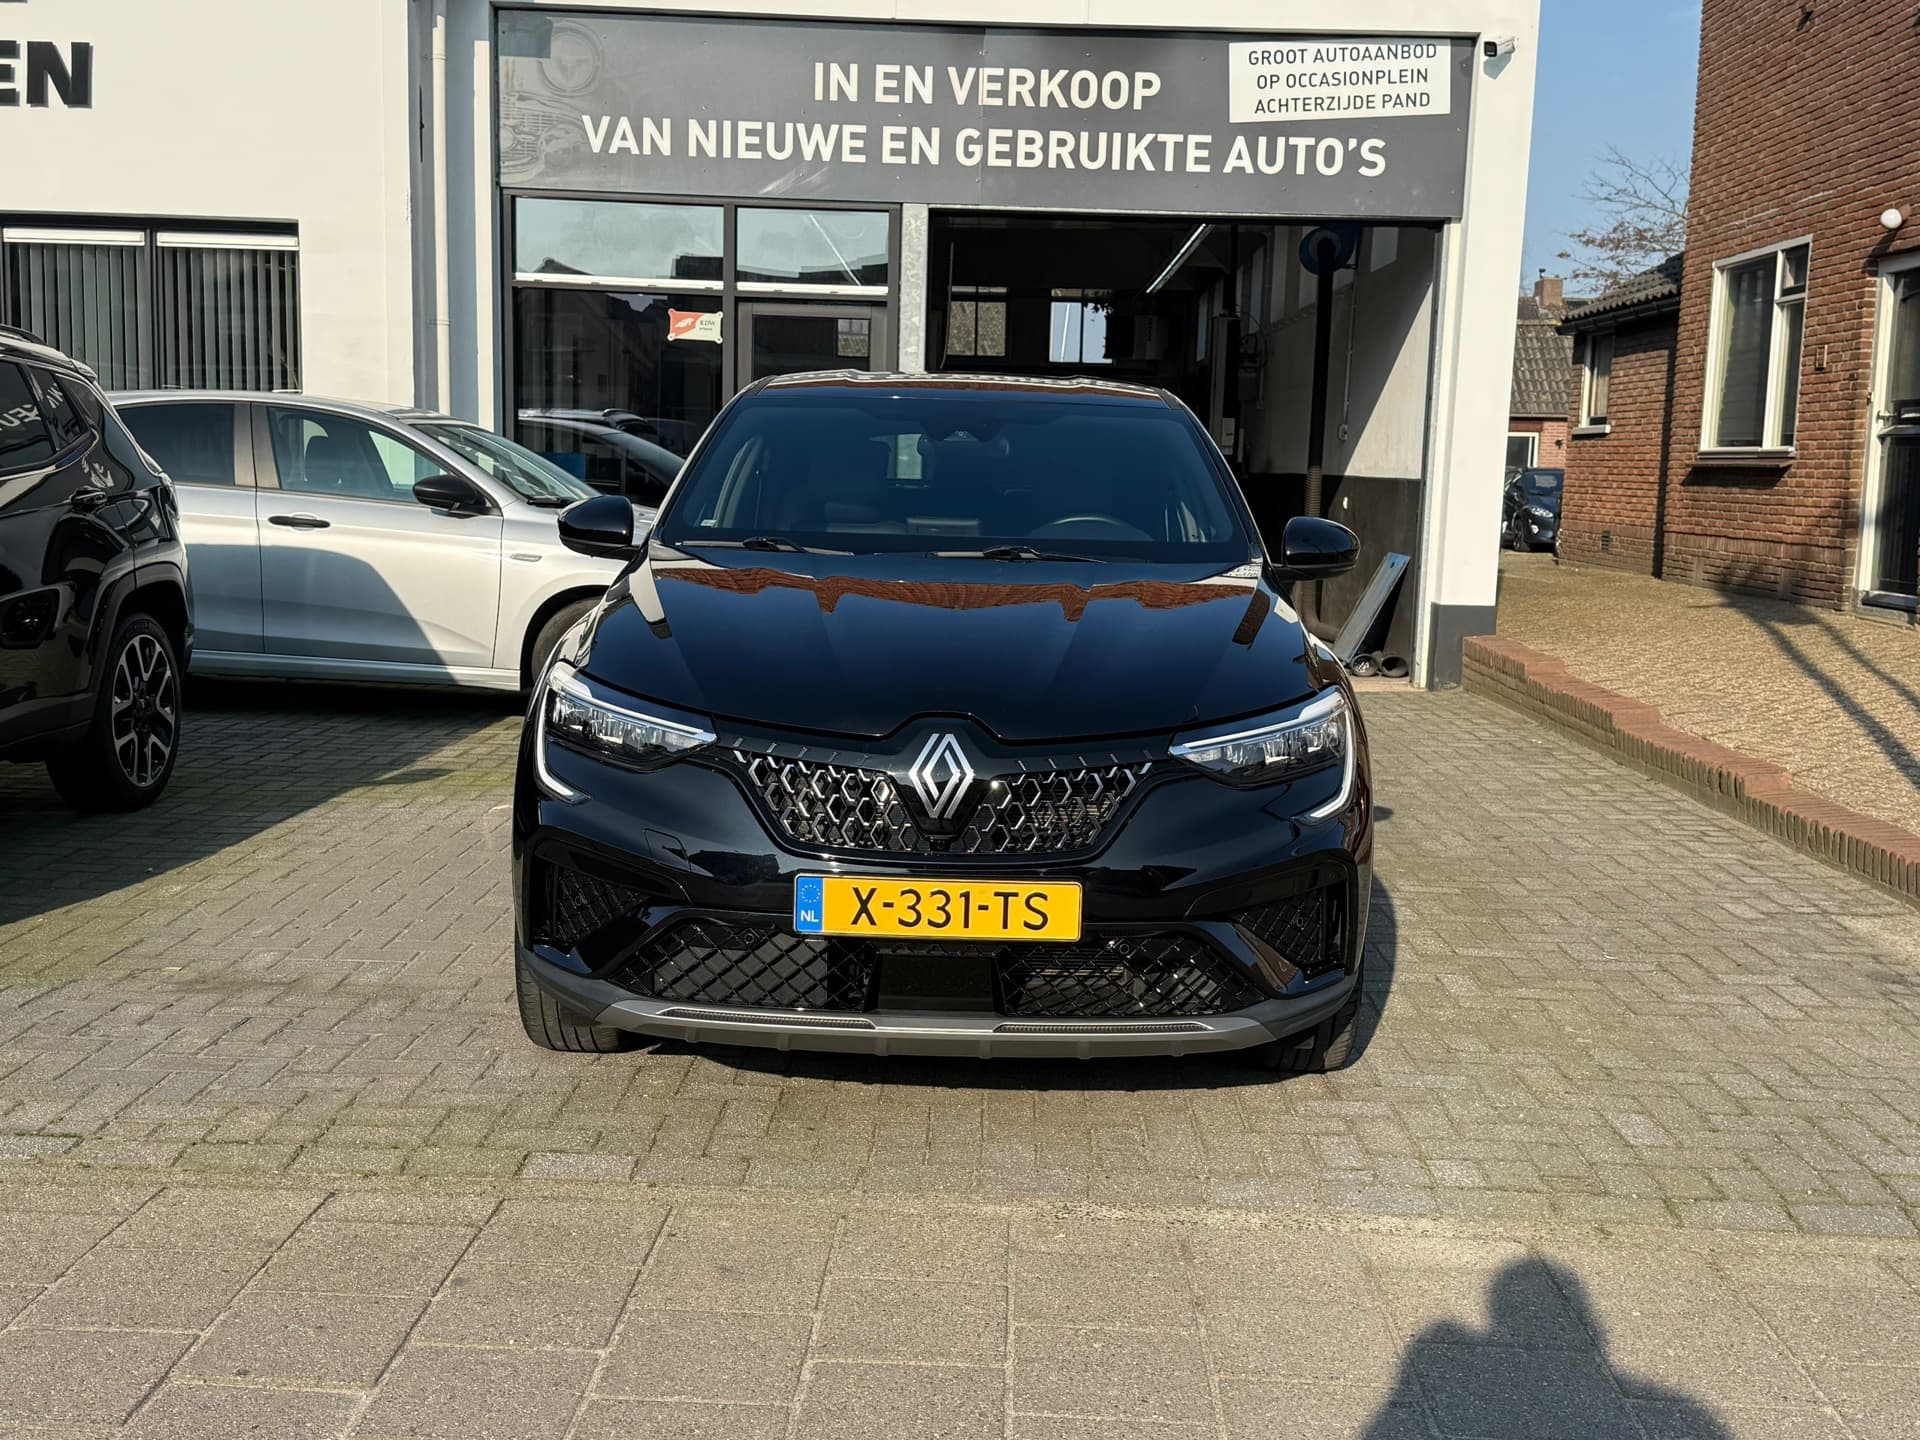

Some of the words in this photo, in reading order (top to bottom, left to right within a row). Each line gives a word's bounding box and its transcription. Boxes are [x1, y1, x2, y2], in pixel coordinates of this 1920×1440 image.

[1249, 48, 1307, 66] GROOT
[1314, 43, 1437, 63] AUTOAANBOD
[814, 61, 859, 102] IN
[874, 63, 934, 105] EN
[947, 66, 1162, 110] VERKOOP
[1257, 73, 1280, 90] OP
[1286, 68, 1428, 89] OCCASIONPLEIN
[1254, 94, 1377, 114] ACHTERZIJDE
[1382, 92, 1430, 109] PAND
[582, 114, 672, 157] VAN
[687, 118, 868, 164] NIEUWE
[881, 125, 941, 167] EN
[955, 127, 1213, 173] GEBRUIKTE
[1223, 136, 1387, 178] AUTO'S
[800, 910, 819, 923] NL
[851, 887, 1049, 931] X-331-TS
